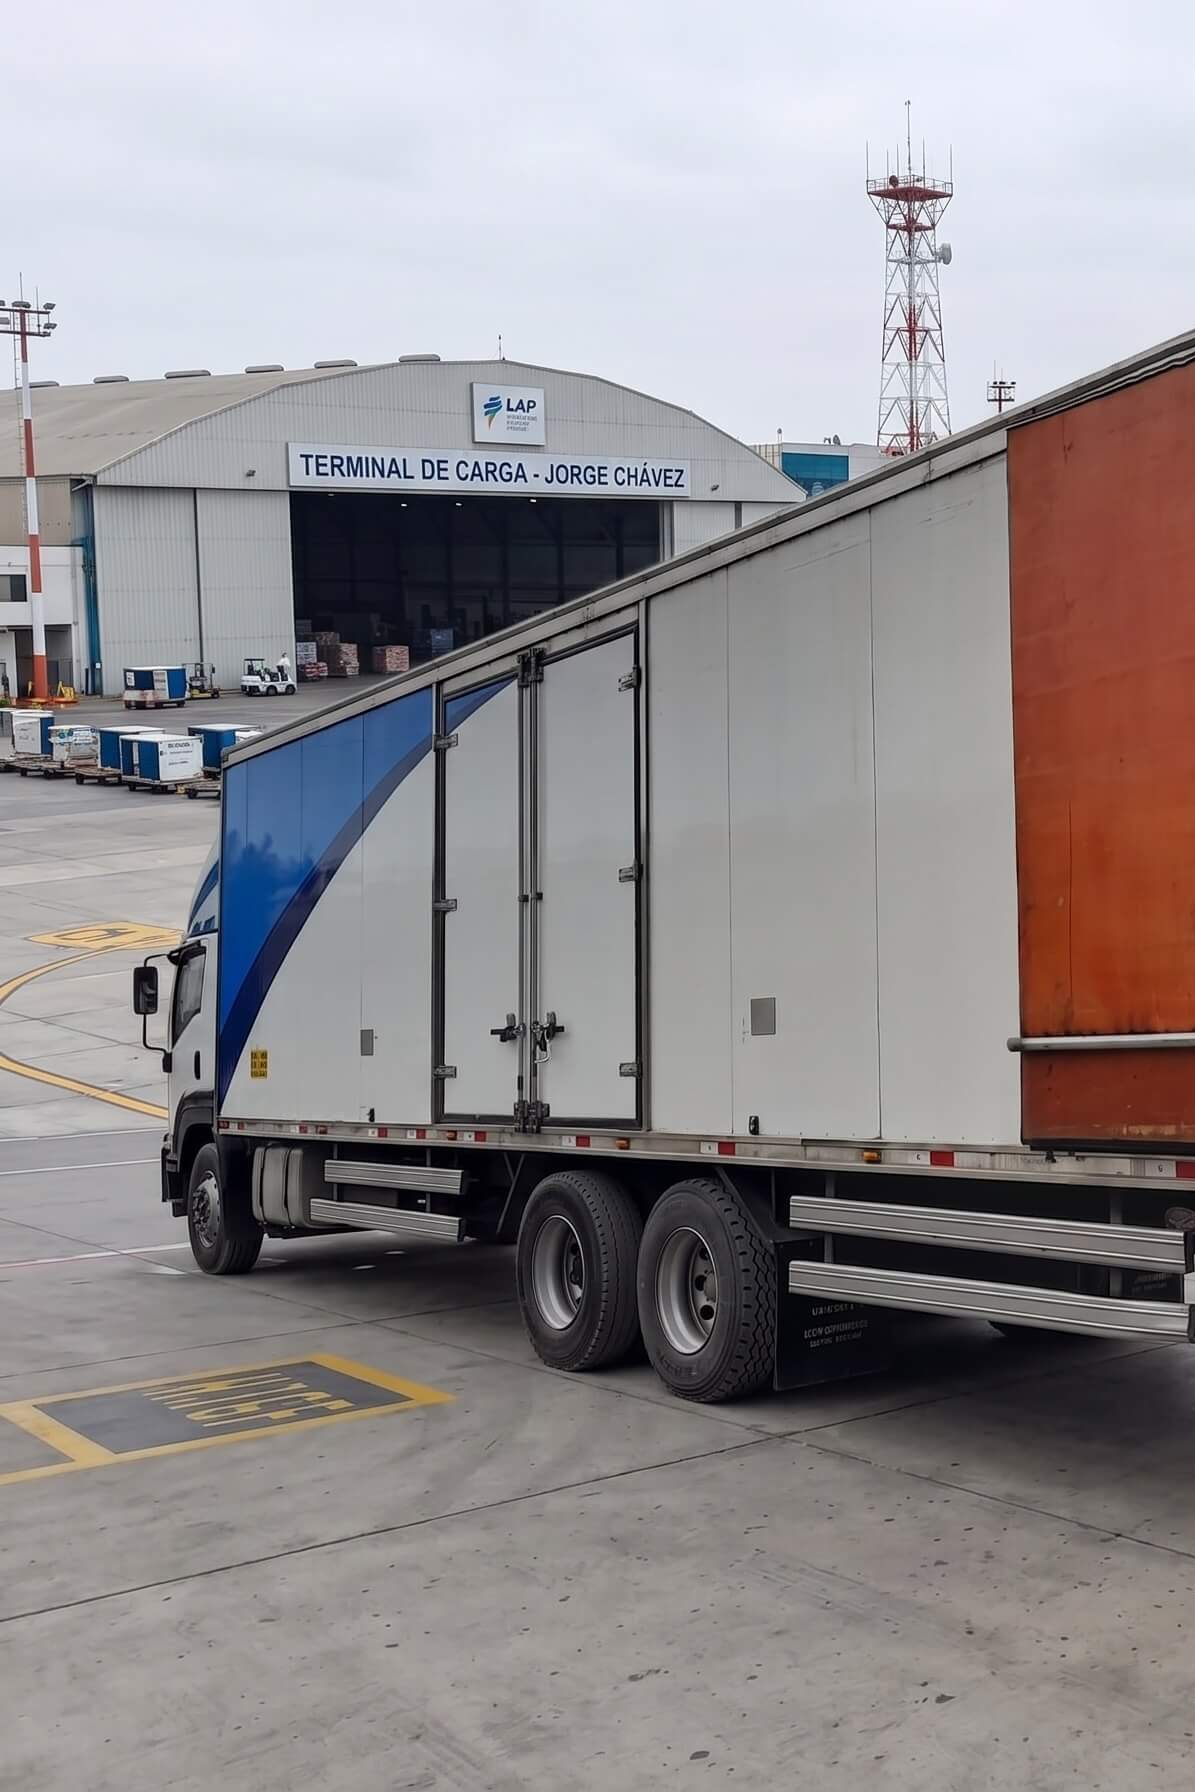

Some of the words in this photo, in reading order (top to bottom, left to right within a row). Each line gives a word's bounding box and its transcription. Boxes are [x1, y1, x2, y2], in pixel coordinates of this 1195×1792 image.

[506, 398, 537, 413] LAP
[299, 453, 415, 480] TERMINAL
[421, 458, 450, 481] DE
[455, 460, 528, 483] CARGA
[544, 463, 609, 486] JORGE
[614, 461, 685, 488] CHÁVEZ
